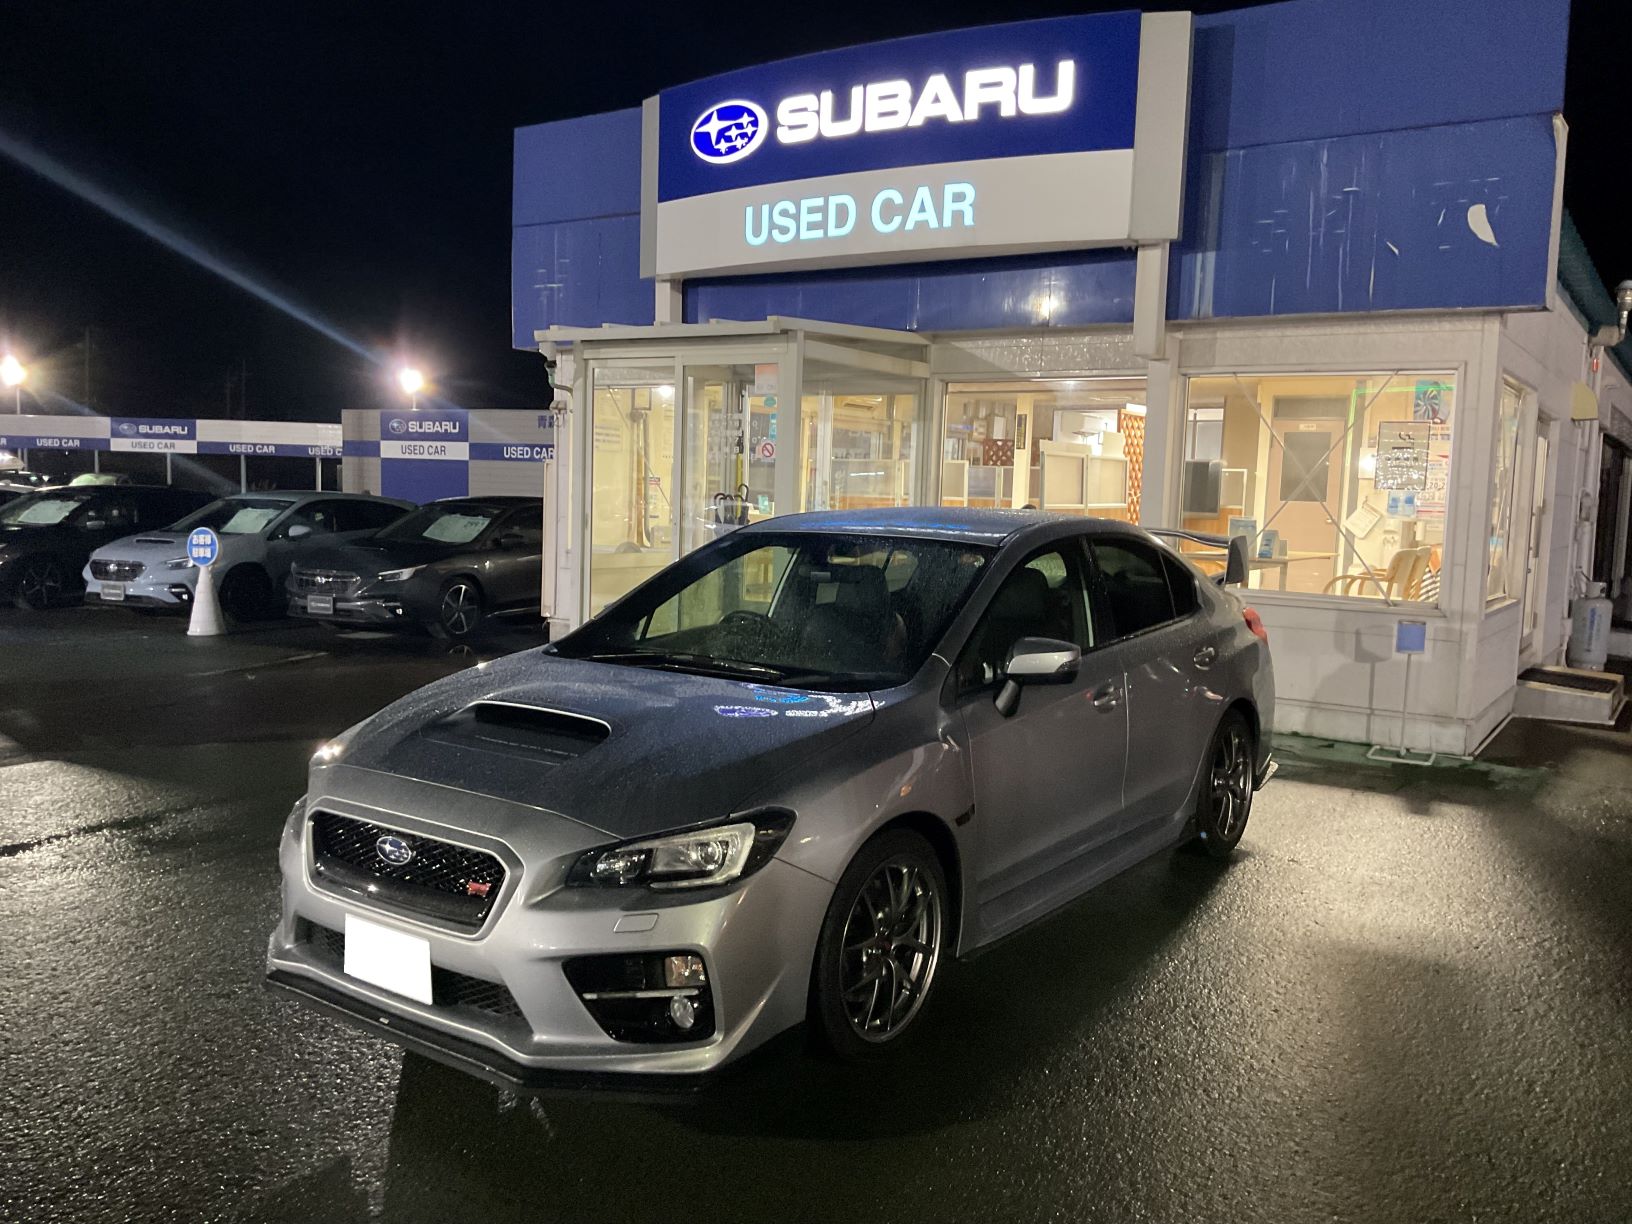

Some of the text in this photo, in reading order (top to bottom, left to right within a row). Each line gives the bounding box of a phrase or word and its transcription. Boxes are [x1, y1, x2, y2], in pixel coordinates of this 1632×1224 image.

[776, 59, 1074, 144] SUBARU
[744, 182, 975, 246] USED CAR
[138, 424, 188, 435] SUBARU
[408, 421, 459, 433] SUBARU
[36, 438, 80, 448] USED CAR
[131, 440, 176, 451] USED CAR
[229, 444, 275, 454] USED CAR
[308, 447, 333, 456] USED
[401, 444, 446, 456] USED CAR
[503, 446, 531, 459] USED
